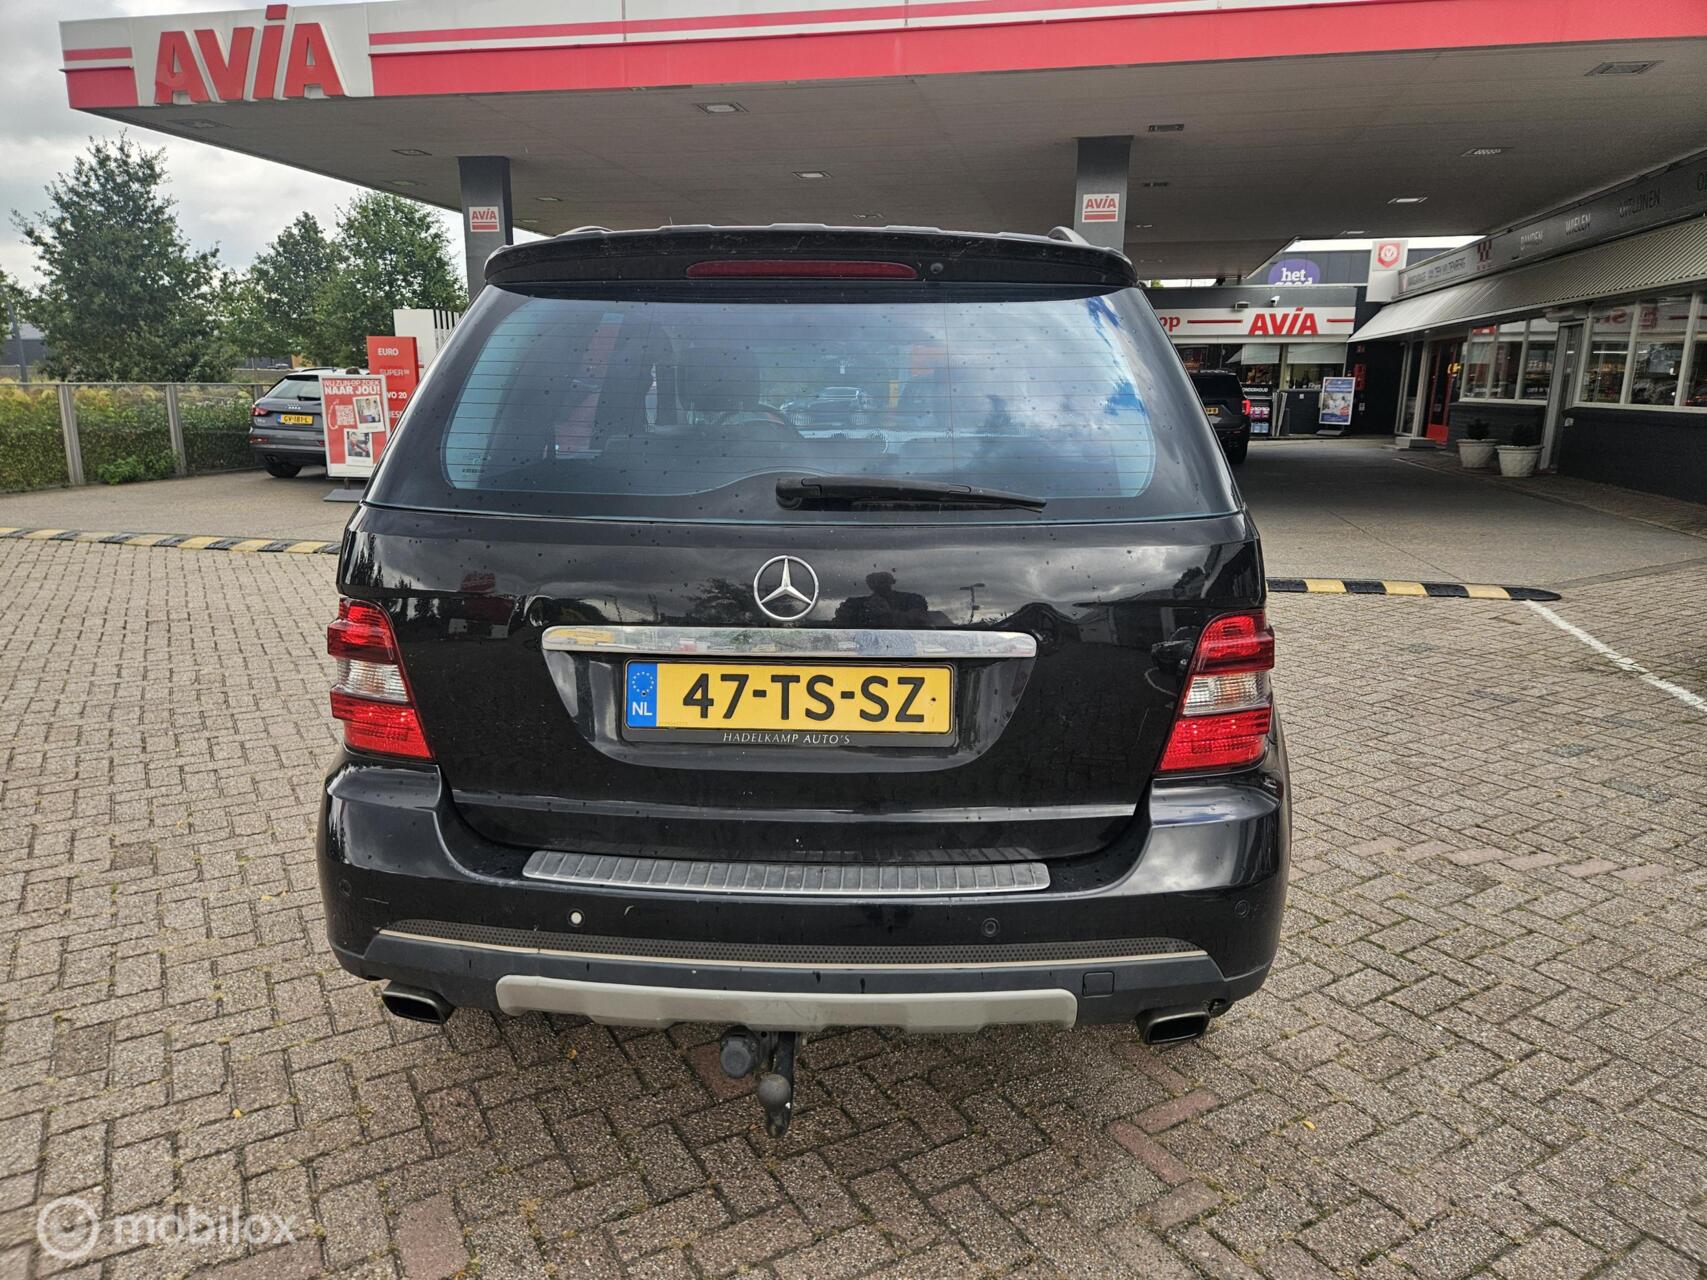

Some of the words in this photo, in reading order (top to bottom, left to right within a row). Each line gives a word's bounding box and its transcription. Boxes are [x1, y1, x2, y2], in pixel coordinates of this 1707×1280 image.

[1281, 267, 1306, 281] het
[377, 347, 399, 356] EURO
[325, 386, 353, 395] NAAR
[355, 386, 381, 395] JOU!
[398, 391, 408, 399] 20
[632, 701, 653, 716] NL
[682, 673, 926, 723] 47-TS-SZ
[722, 732, 799, 744] HADELKAMP
[803, 733, 850, 745] AUTO'S
